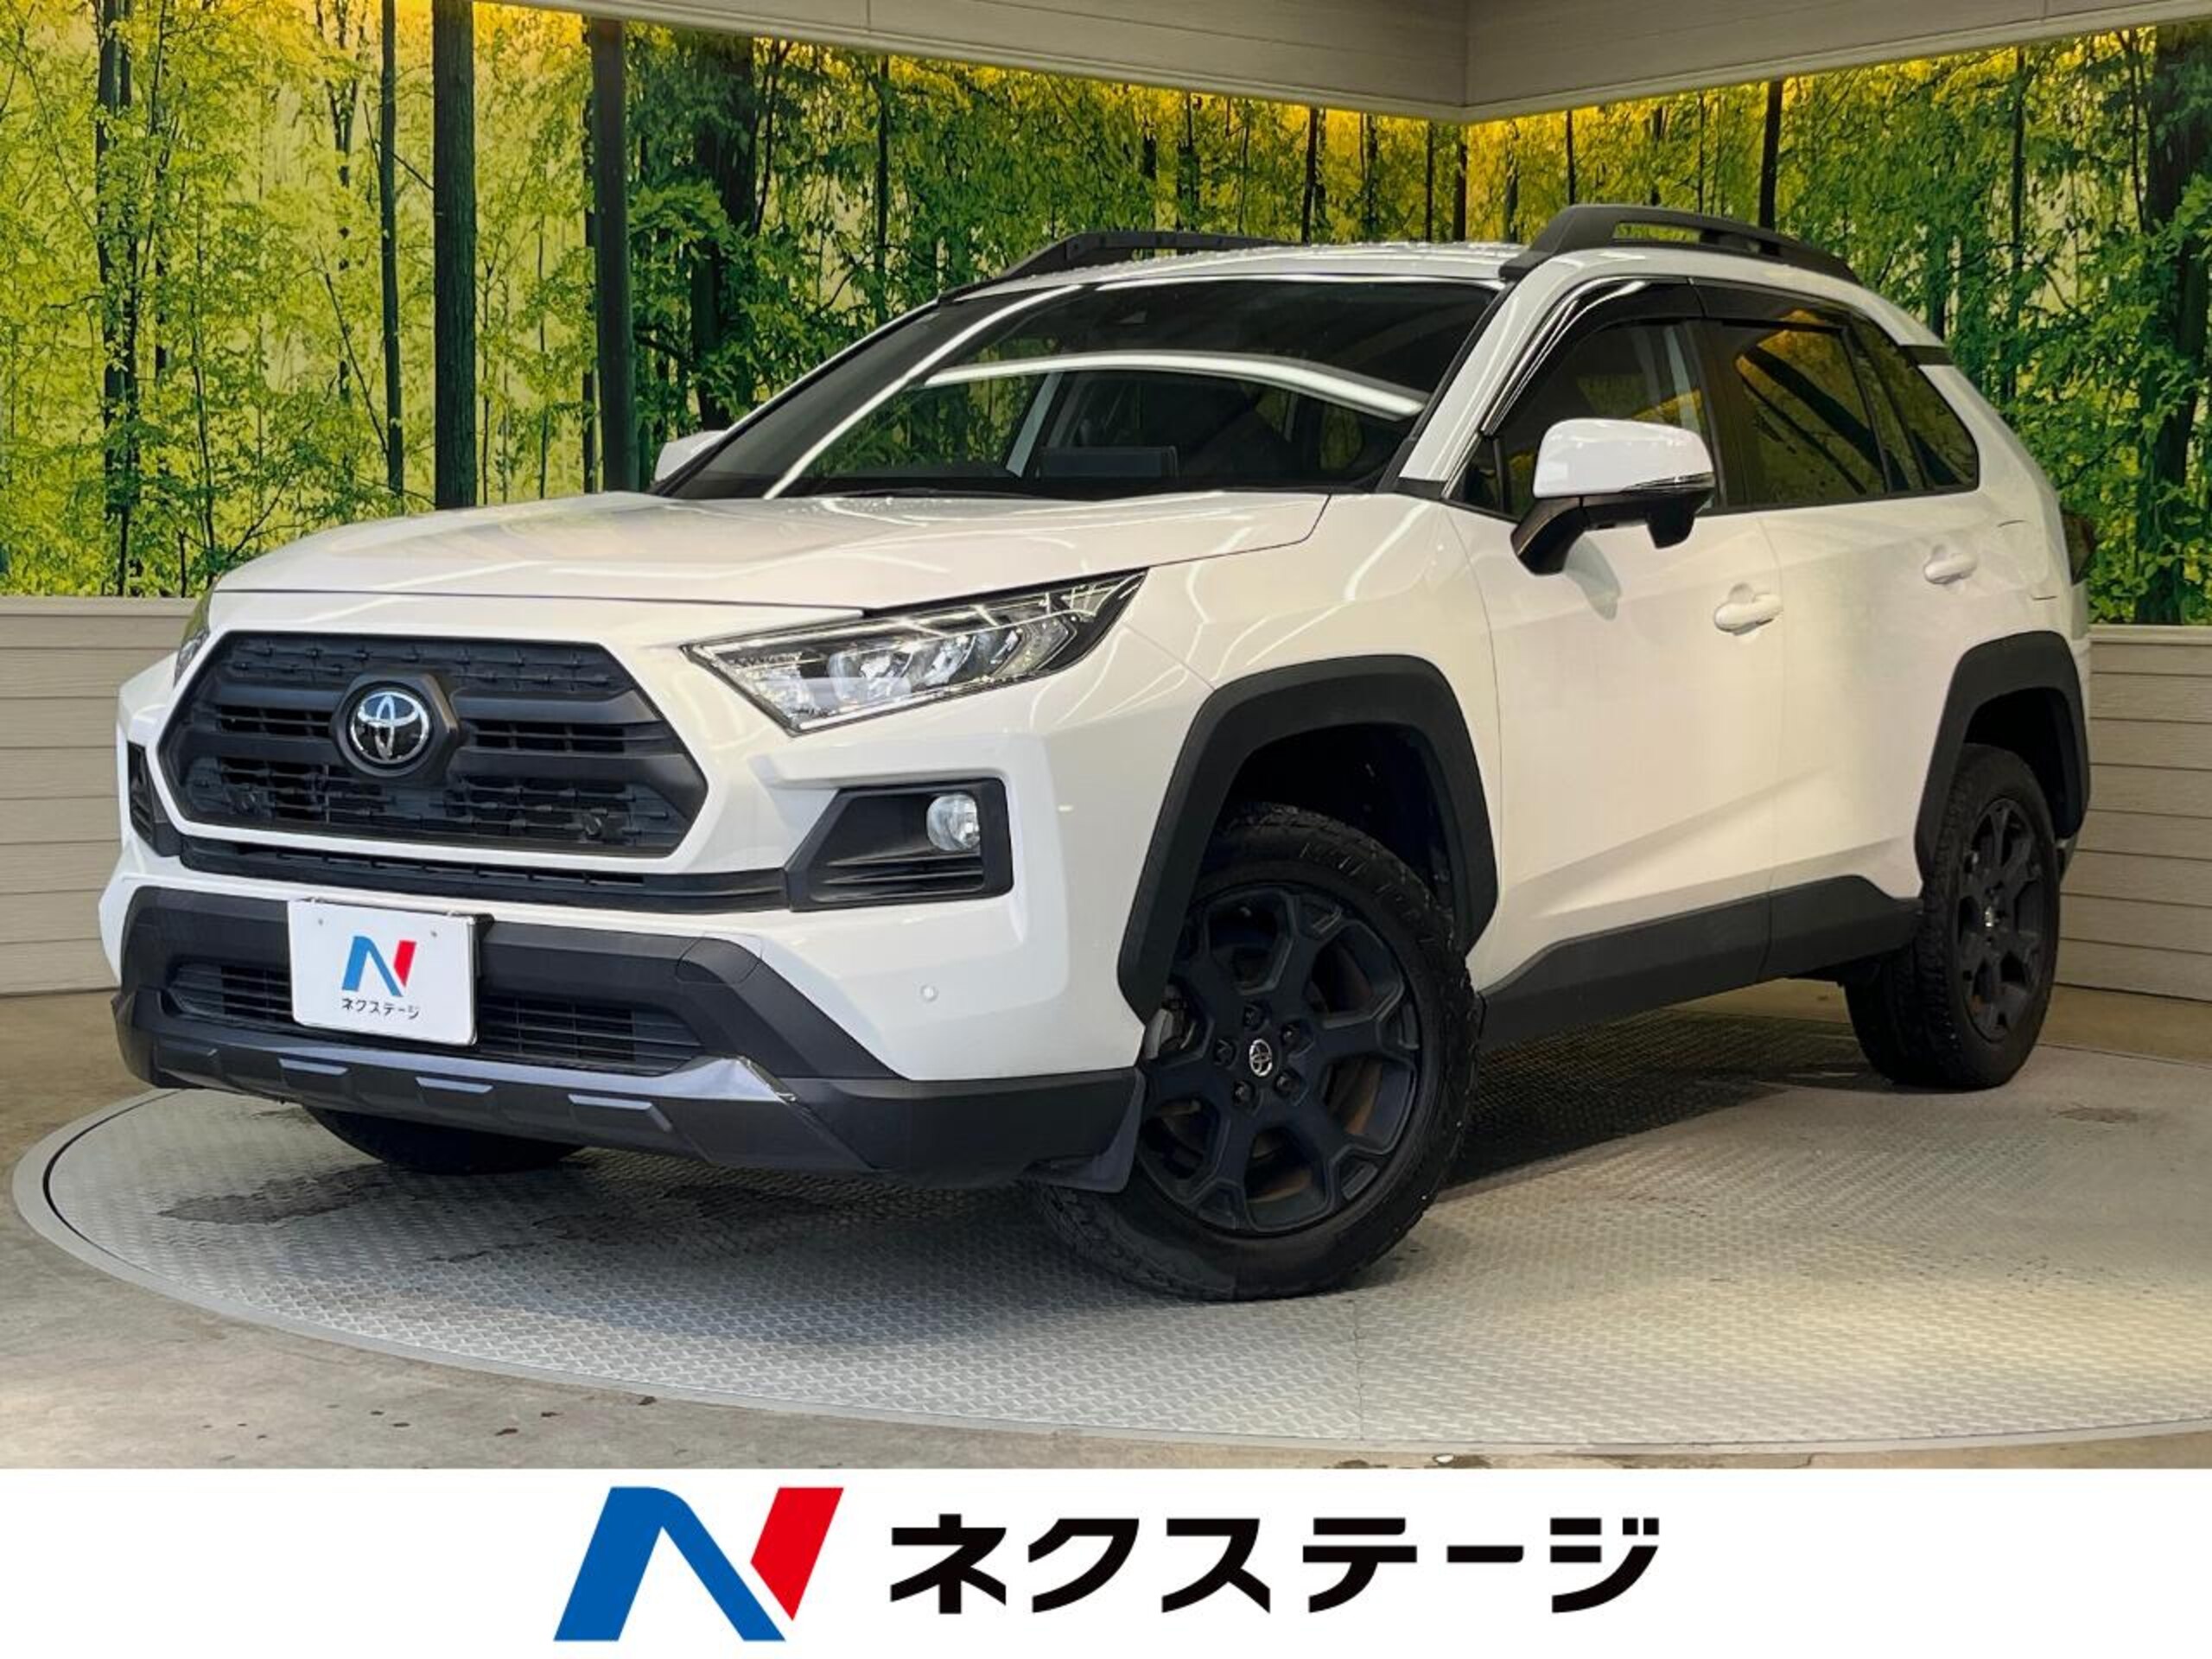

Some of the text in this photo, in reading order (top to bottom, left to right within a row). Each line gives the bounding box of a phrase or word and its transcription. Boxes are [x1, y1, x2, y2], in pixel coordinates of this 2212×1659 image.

[342, 998, 419, 1020] ネクステージ
